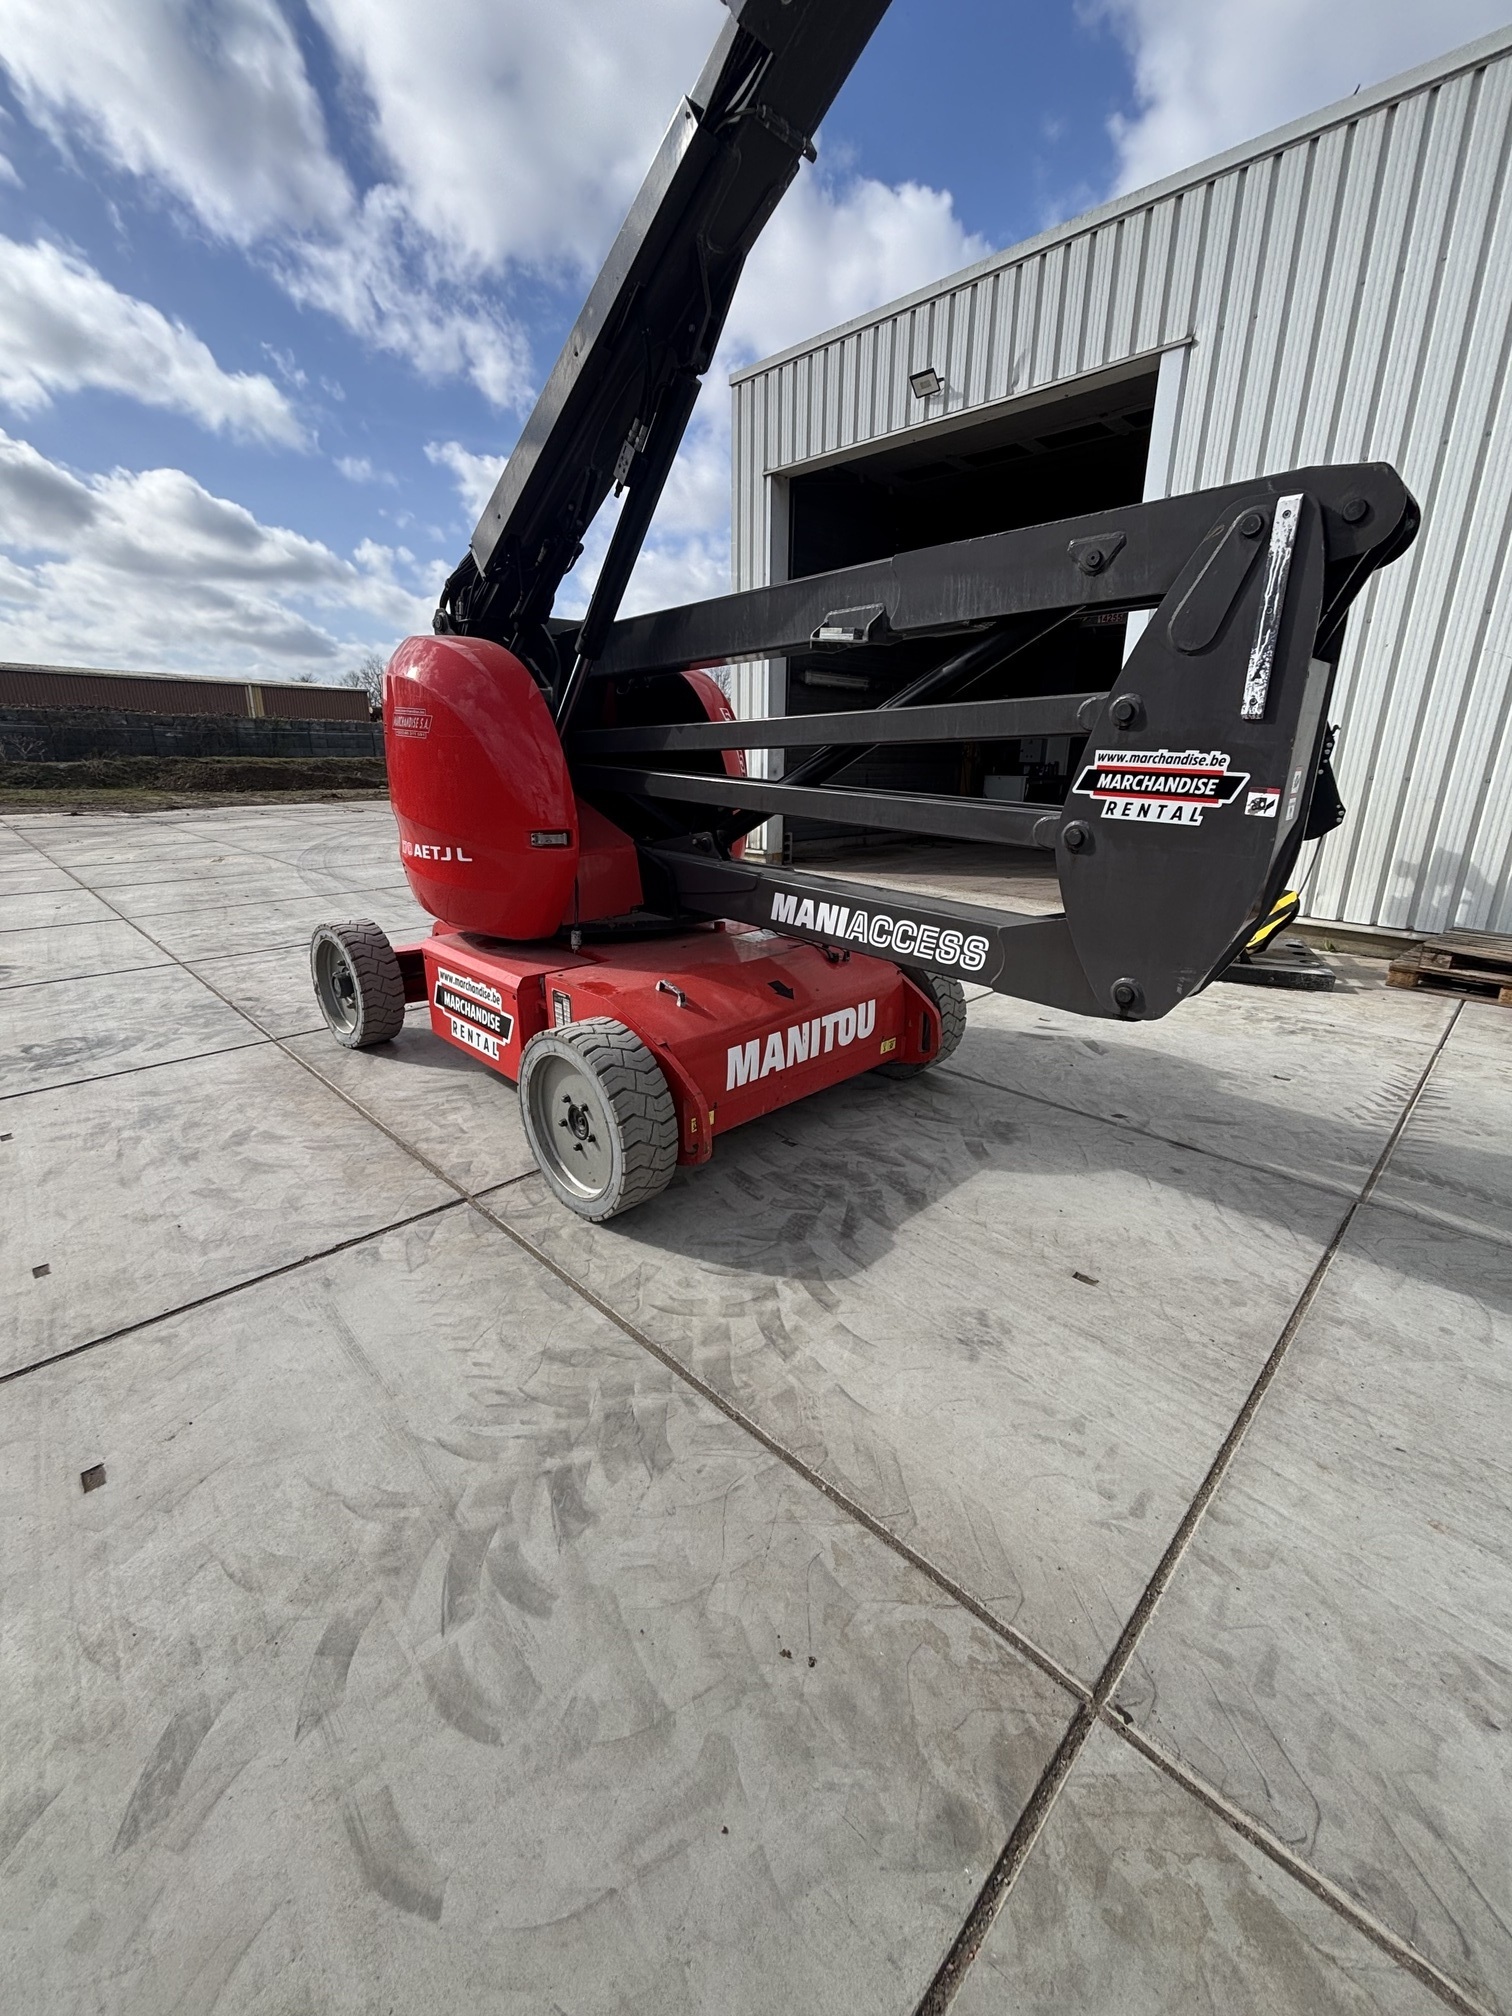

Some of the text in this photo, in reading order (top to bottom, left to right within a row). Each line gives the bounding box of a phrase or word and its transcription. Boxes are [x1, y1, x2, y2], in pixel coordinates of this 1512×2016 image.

[1097, 752, 1227, 767] www.marchandise.be
[1097, 773, 1219, 795] MARCHANDISE
[1105, 801, 1200, 823] RENTAL
[770, 892, 989, 971] MANIACCESS
[440, 971, 501, 1006] www.marchandise.be
[444, 991, 501, 1032] MARCHANDISE
[452, 1020, 498, 1057] RENTAL
[726, 999, 876, 1091] MANITOU
